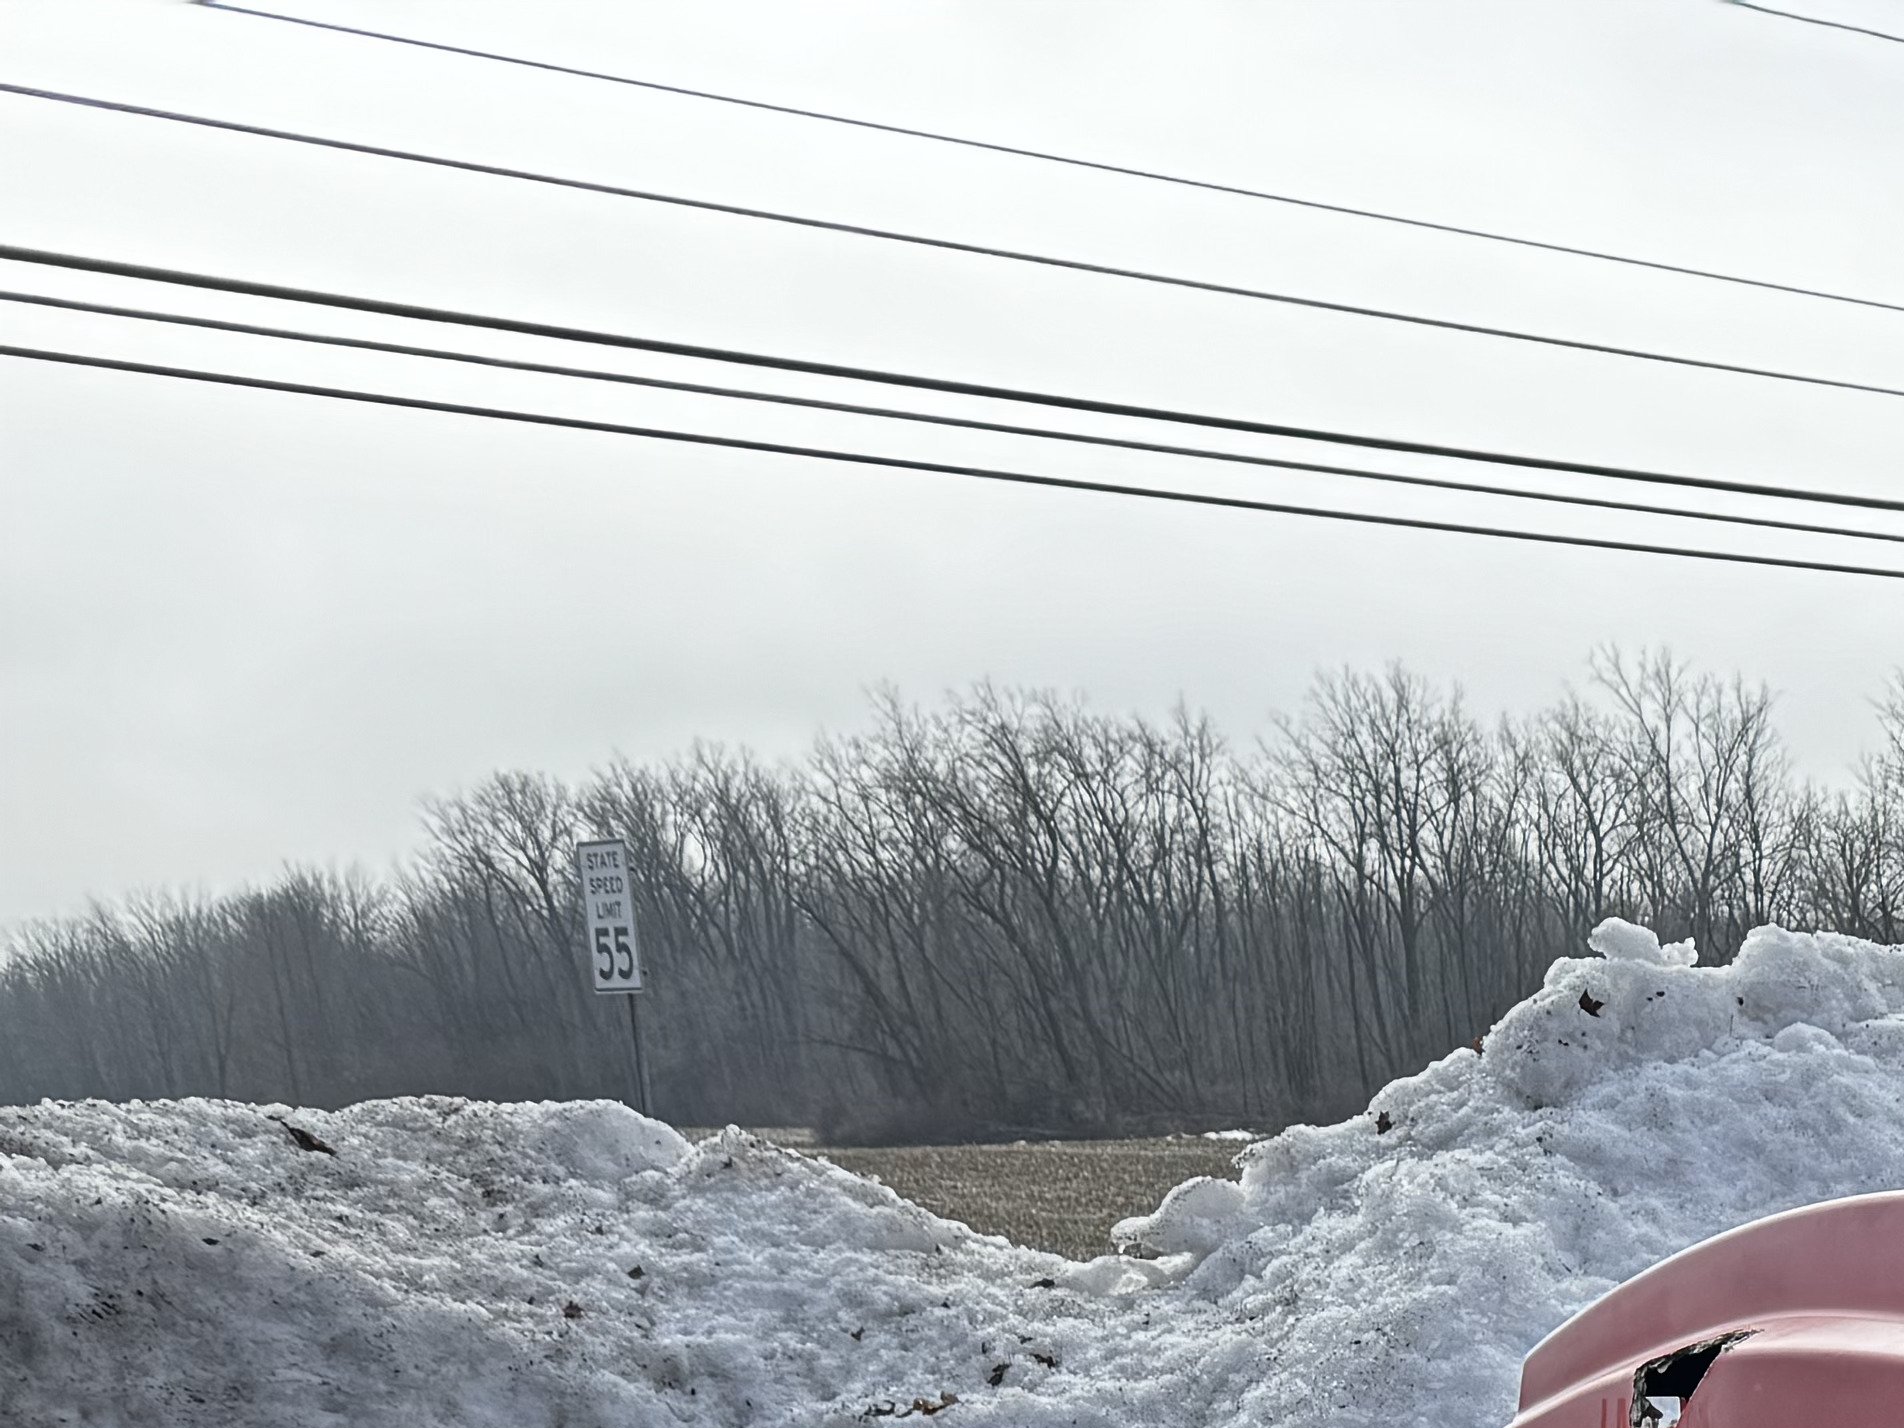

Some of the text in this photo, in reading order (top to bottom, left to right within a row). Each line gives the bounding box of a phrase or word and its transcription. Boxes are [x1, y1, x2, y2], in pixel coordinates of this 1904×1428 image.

[586, 851, 620, 871] STATE
[589, 876, 624, 895] SPEED
[596, 901, 622, 920] LIMIT
[595, 927, 634, 981] 55
